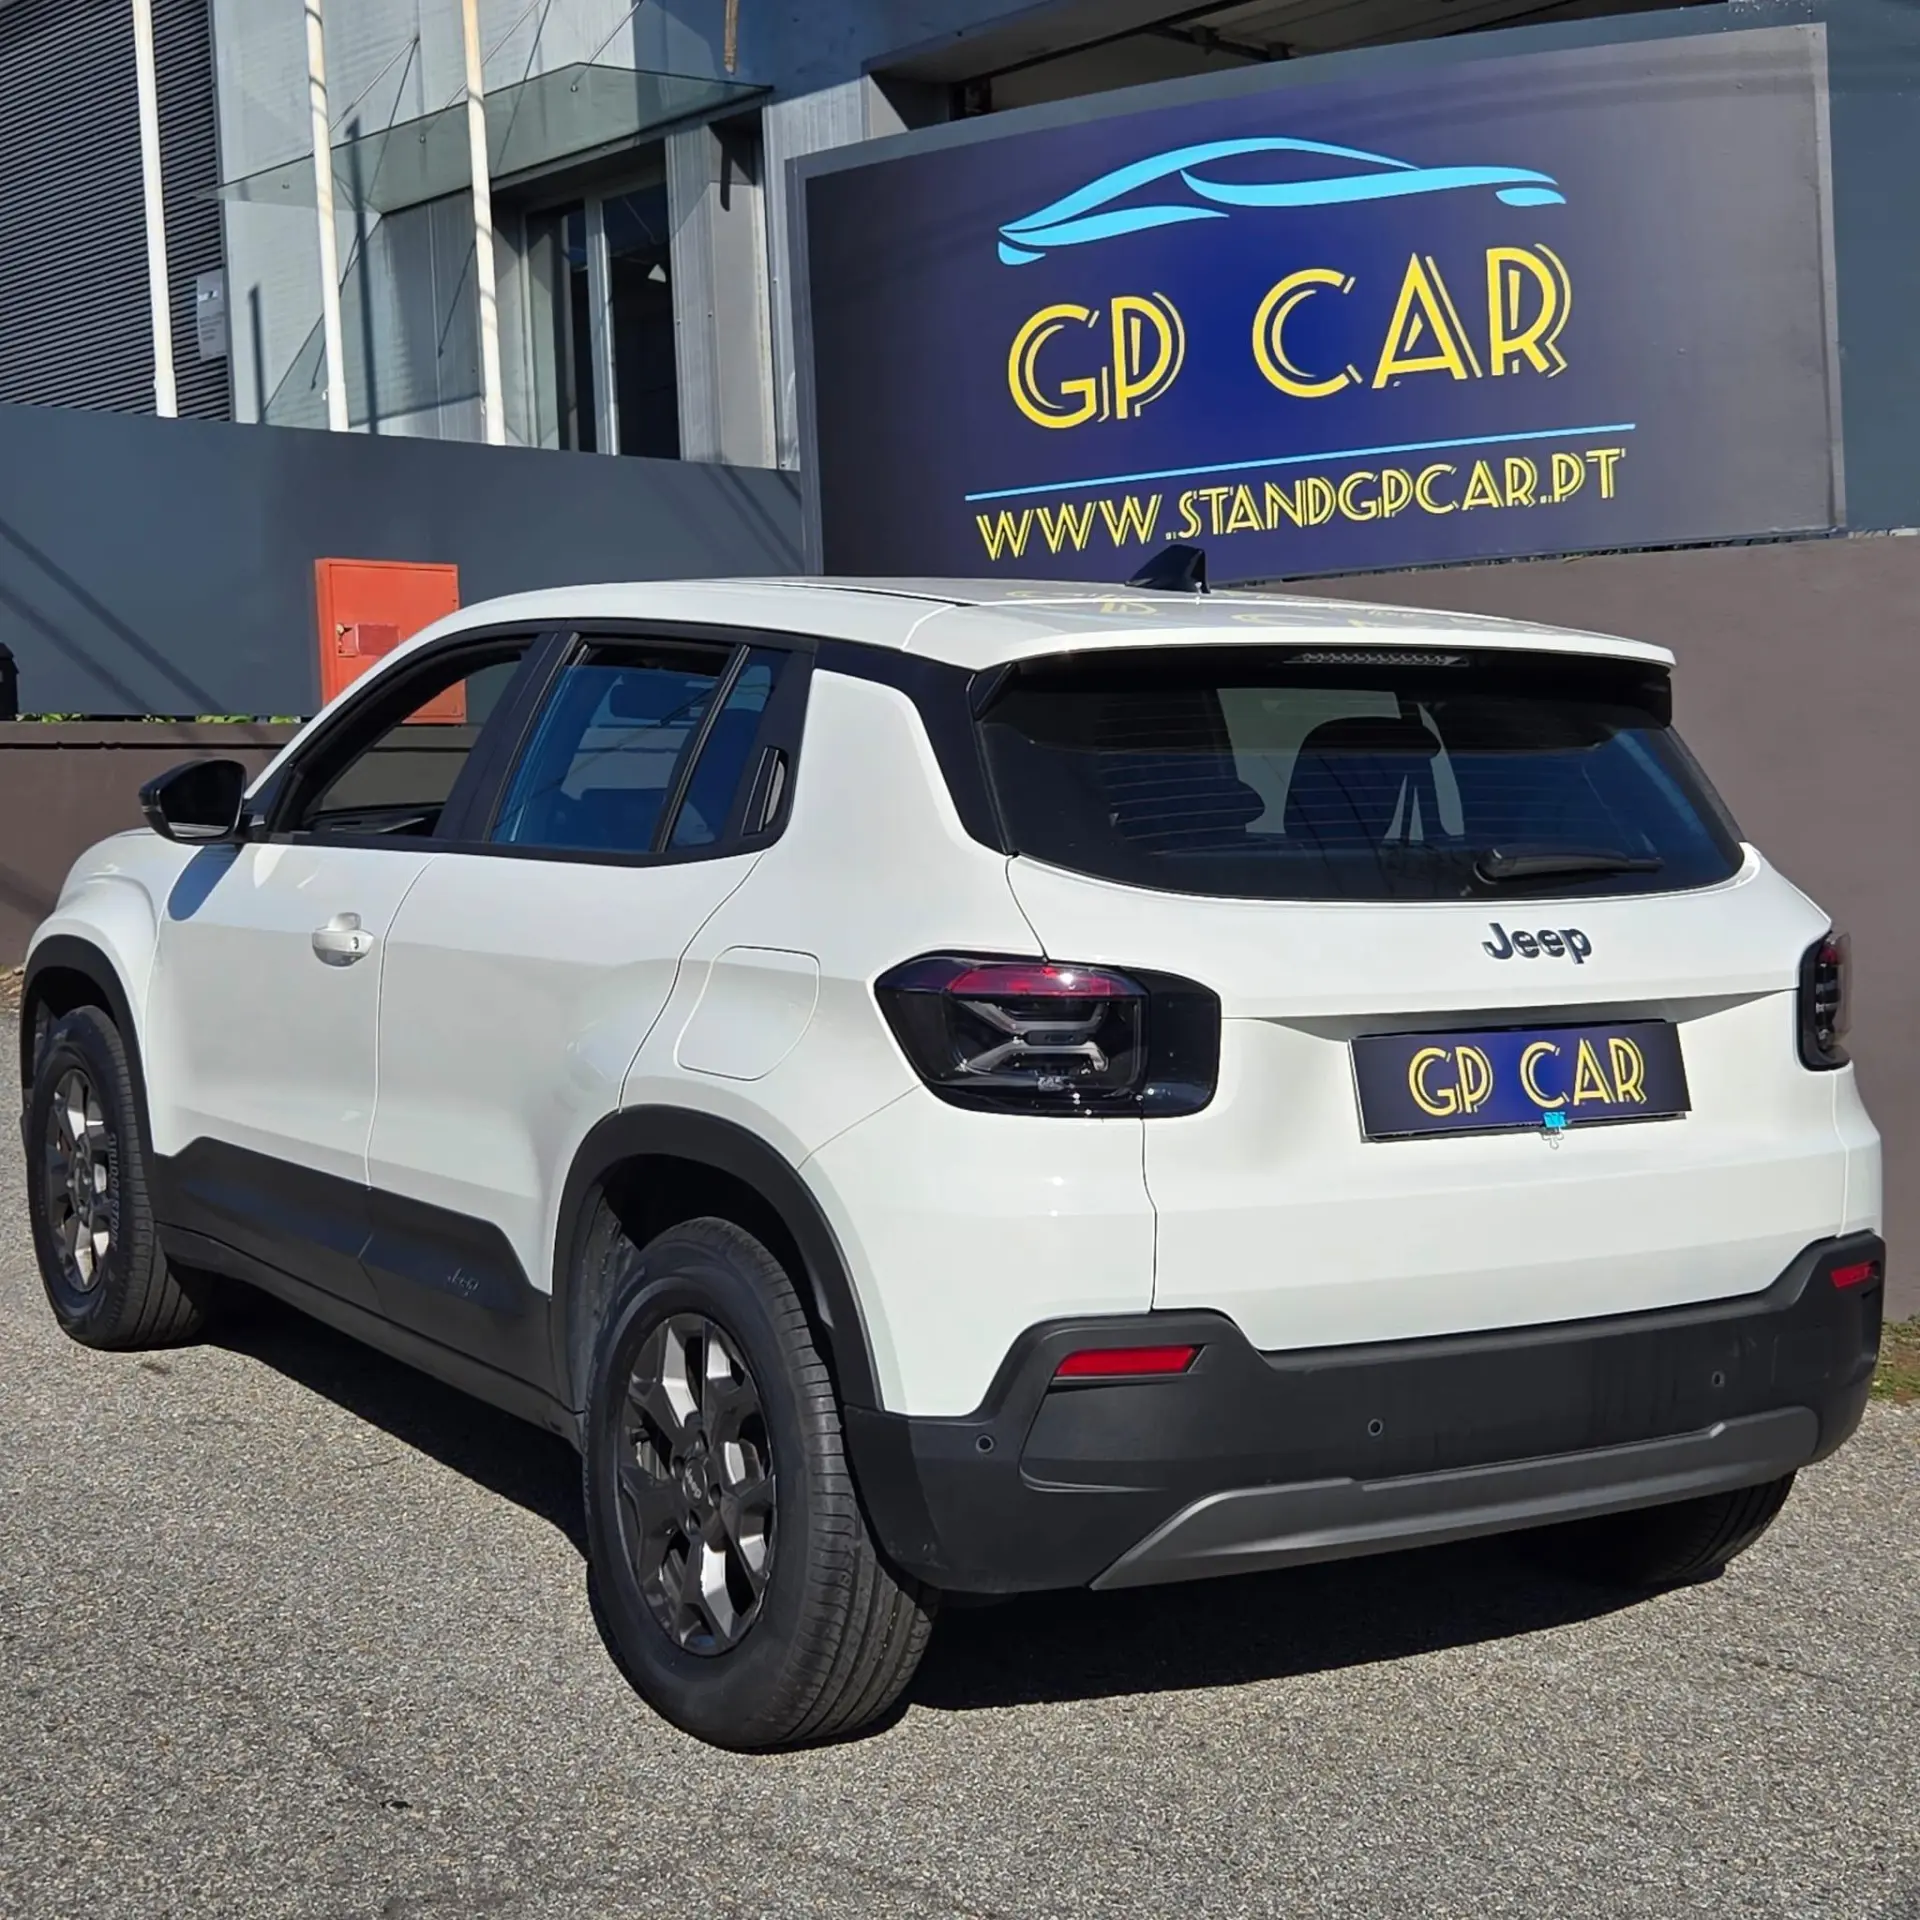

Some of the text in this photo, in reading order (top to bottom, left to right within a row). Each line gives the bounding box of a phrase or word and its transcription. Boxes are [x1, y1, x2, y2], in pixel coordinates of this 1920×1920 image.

[1008, 243, 1572, 428] GP CAR
[976, 447, 1628, 561] WWW.STANDGPCAR.PT
[1481, 922, 1593, 965] Jeep
[1408, 1037, 1647, 1117] GP CAR
